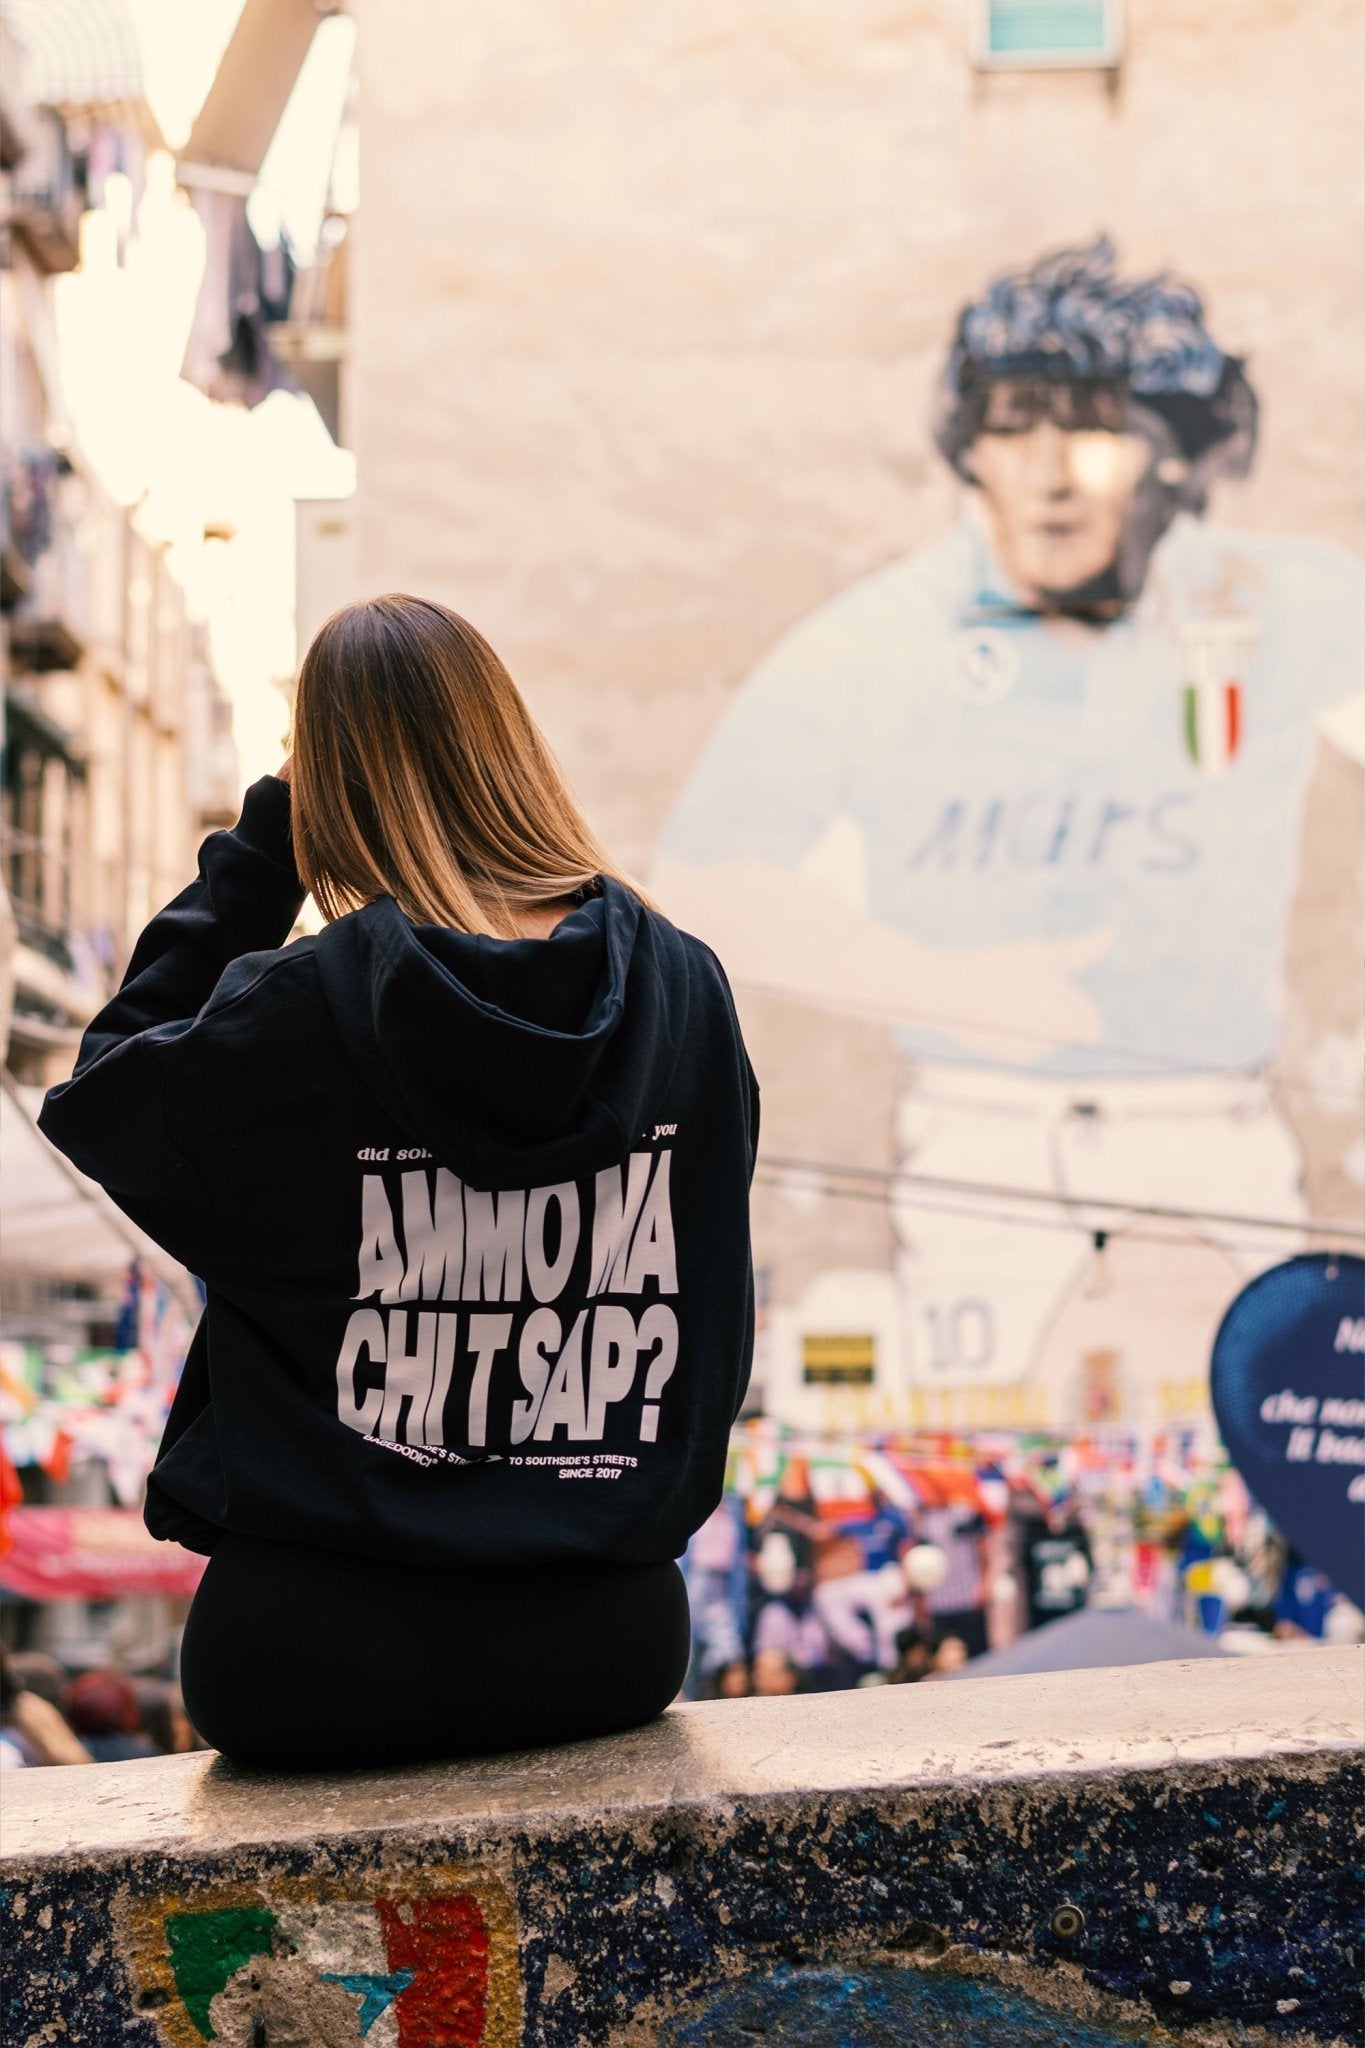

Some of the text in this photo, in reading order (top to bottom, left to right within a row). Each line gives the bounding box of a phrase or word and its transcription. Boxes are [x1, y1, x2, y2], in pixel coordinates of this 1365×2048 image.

[652, 1123, 678, 1141] you
[356, 1147, 390, 1161] did
[349, 1166, 581, 1304] AMMO
[924, 1296, 997, 1374] 10
[336, 1308, 457, 1447] CHI
[510, 1303, 680, 1446] SAP?
[509, 1454, 638, 1468] TO SOUTHSIDE'S STREETS
[558, 1467, 622, 1480] SINCE 2017
